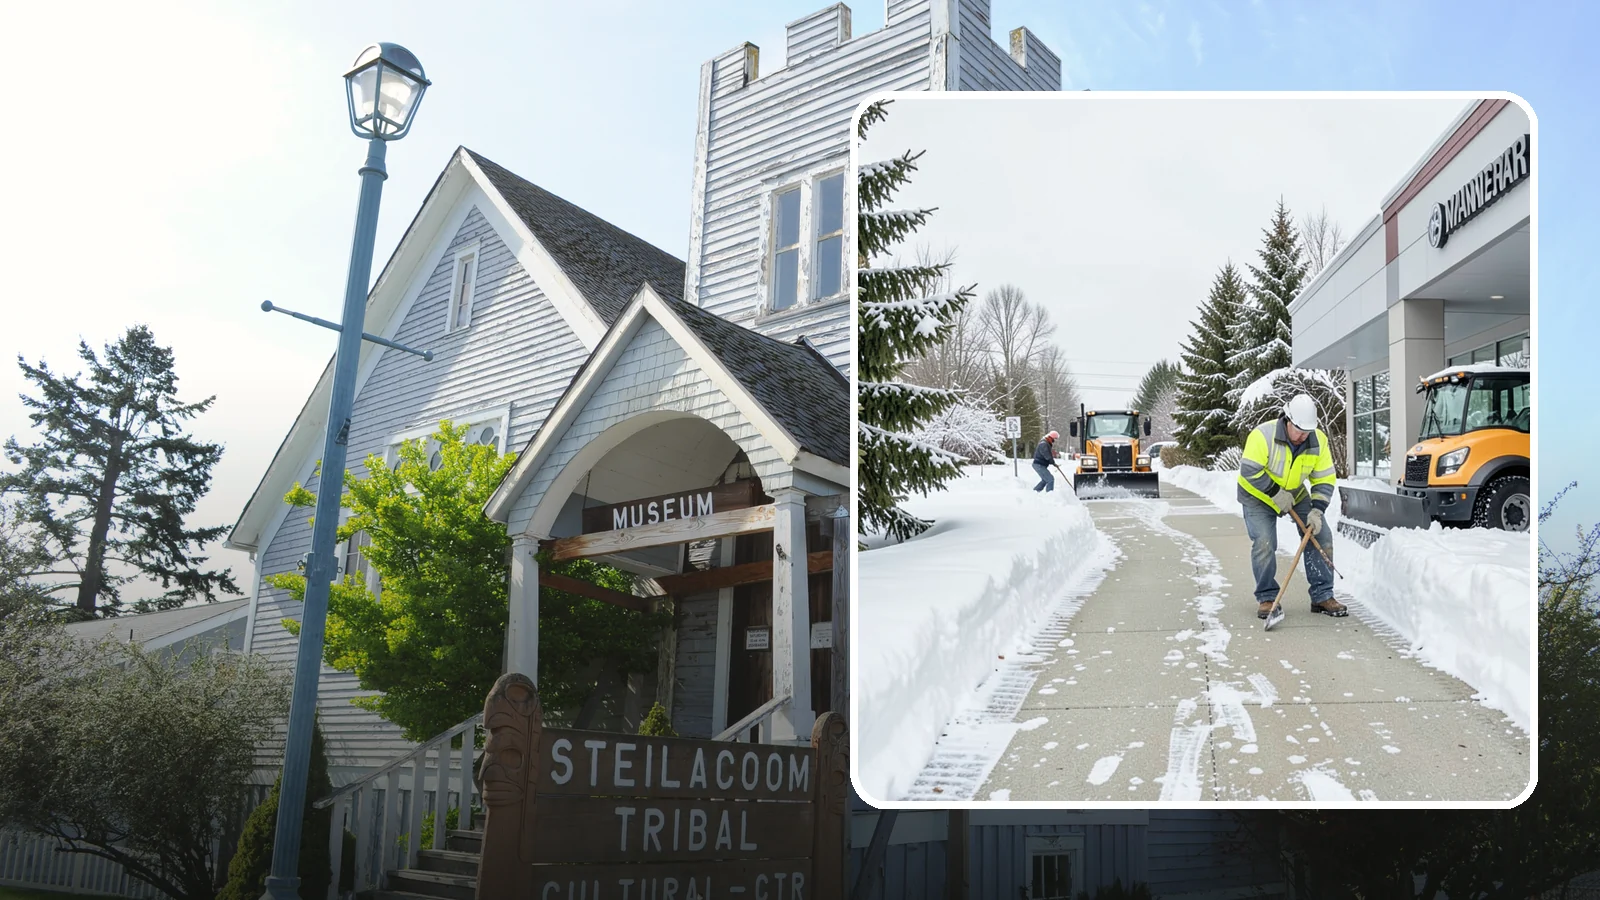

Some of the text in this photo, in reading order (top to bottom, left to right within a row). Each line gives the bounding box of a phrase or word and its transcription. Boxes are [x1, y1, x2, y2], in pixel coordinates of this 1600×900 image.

[613, 491, 713, 530] MUSEUM
[550, 738, 811, 793] STEILACOOM
[614, 806, 758, 852] TRIBAL
